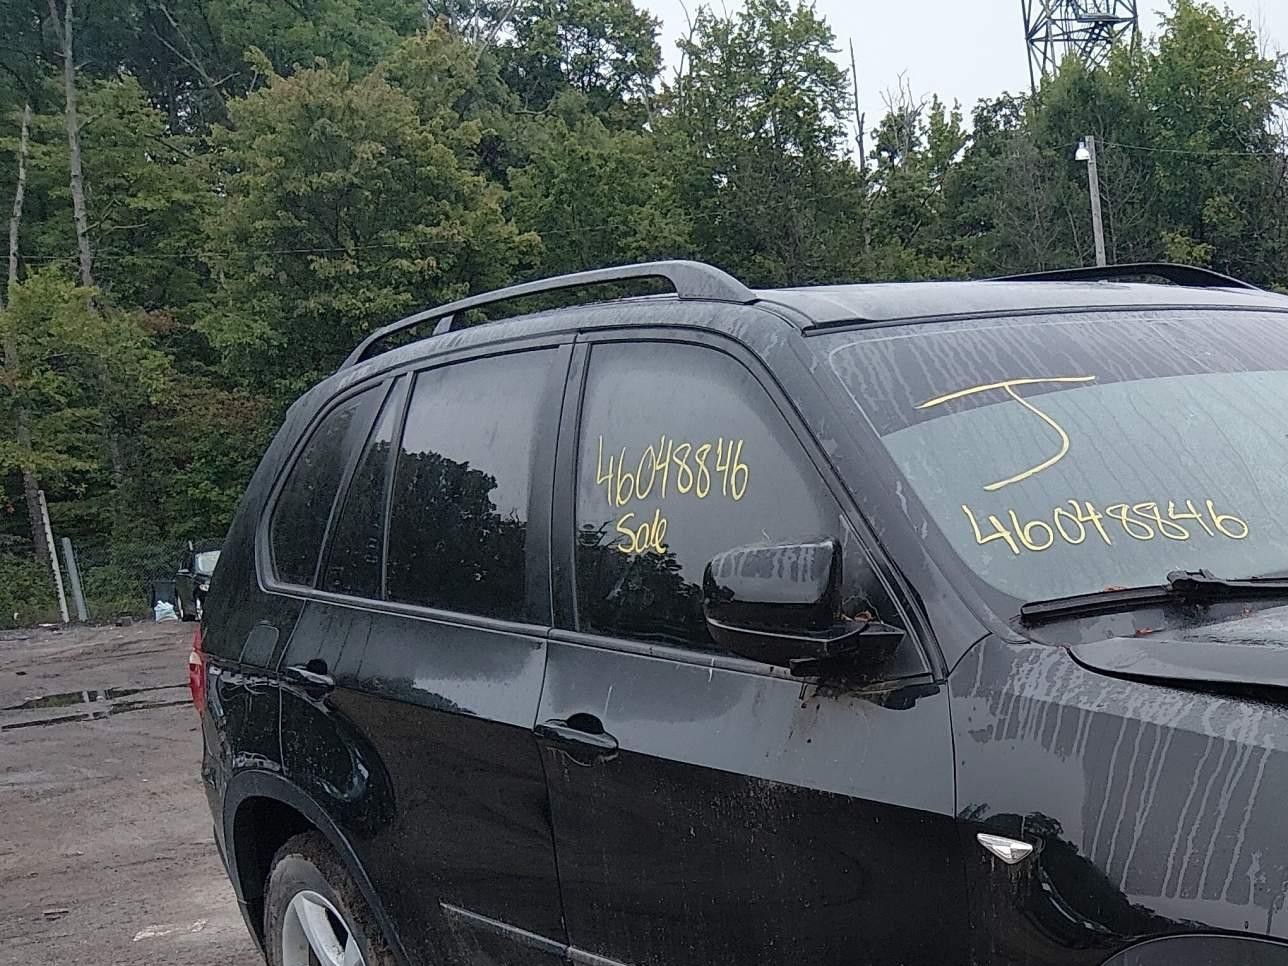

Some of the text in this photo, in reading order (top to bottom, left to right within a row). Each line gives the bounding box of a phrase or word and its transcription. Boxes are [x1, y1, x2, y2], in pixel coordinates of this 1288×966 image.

[596, 434, 749, 507] 46048846
[616, 508, 668, 554] Sale
[961, 499, 1249, 555] 46048846
